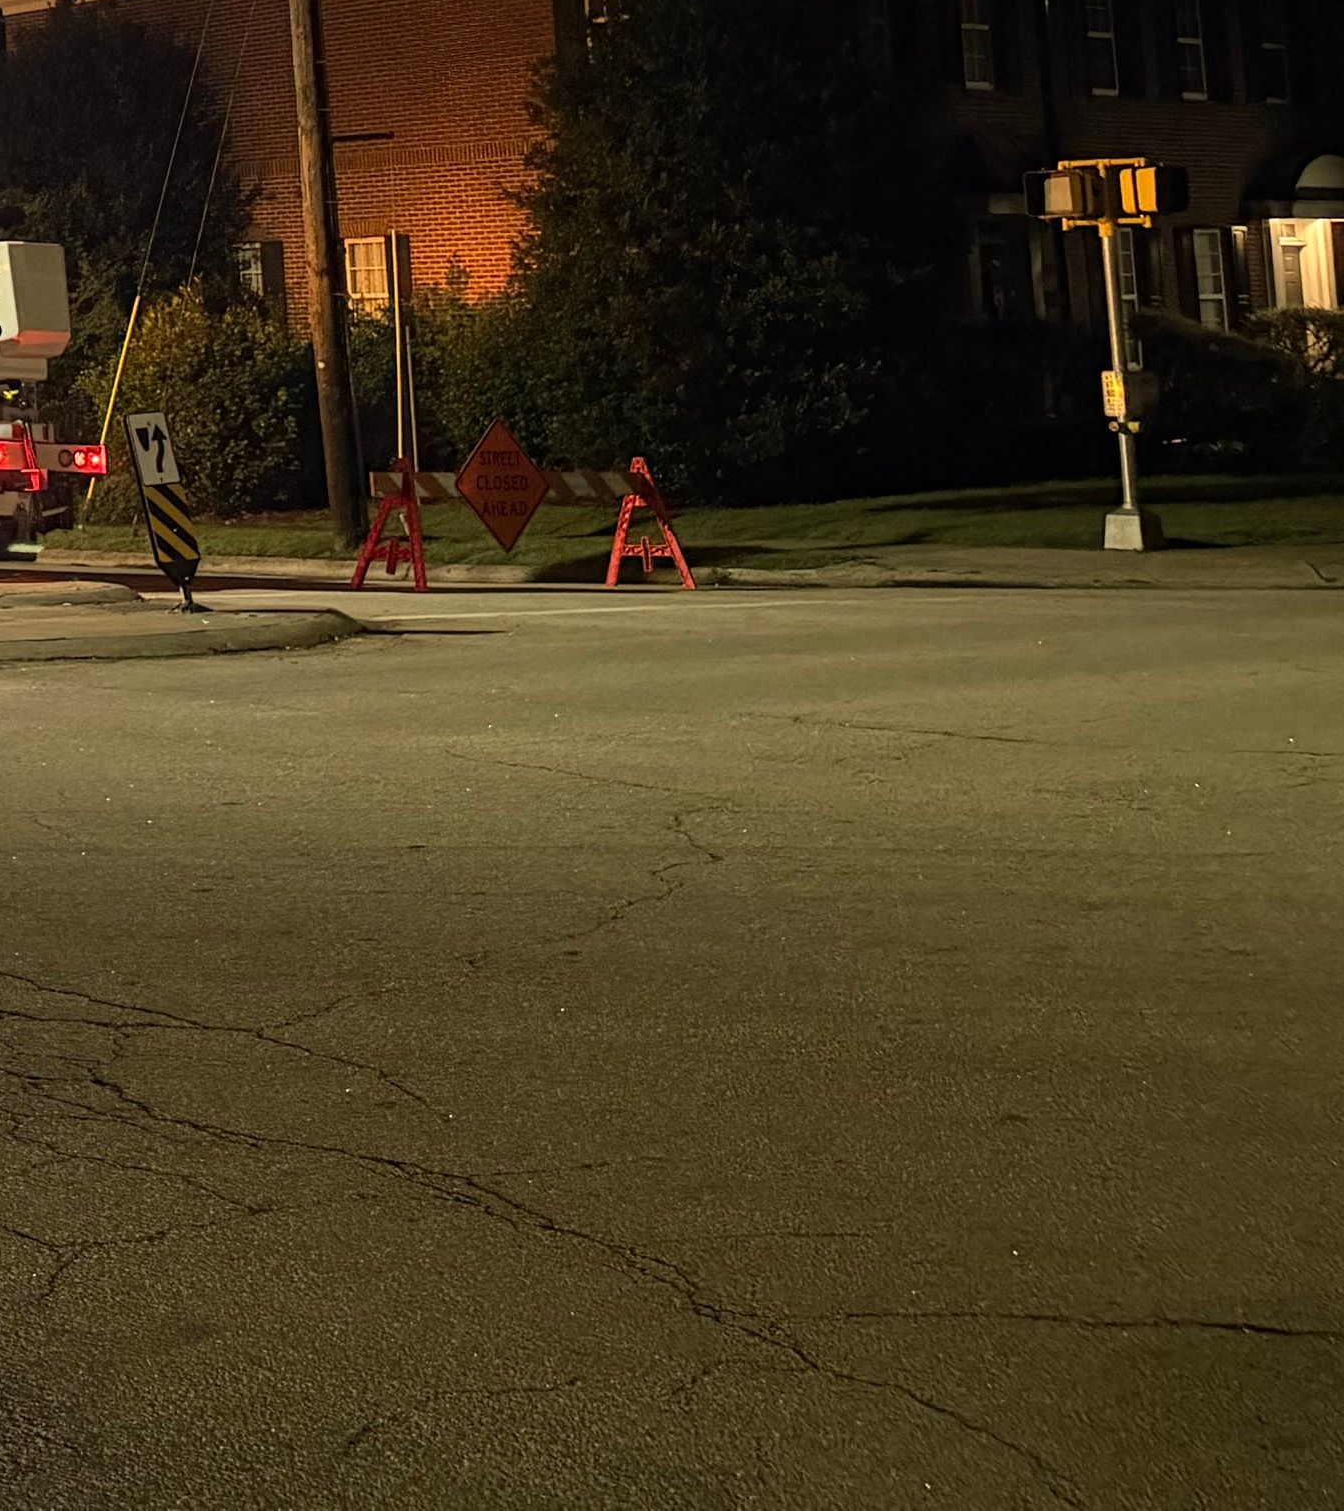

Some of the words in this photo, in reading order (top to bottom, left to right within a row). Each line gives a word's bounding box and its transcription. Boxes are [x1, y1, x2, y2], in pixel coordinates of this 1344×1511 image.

[479, 450, 521, 466] STREET
[476, 474, 529, 492] CLOSED
[482, 500, 528, 518] AHEAD
